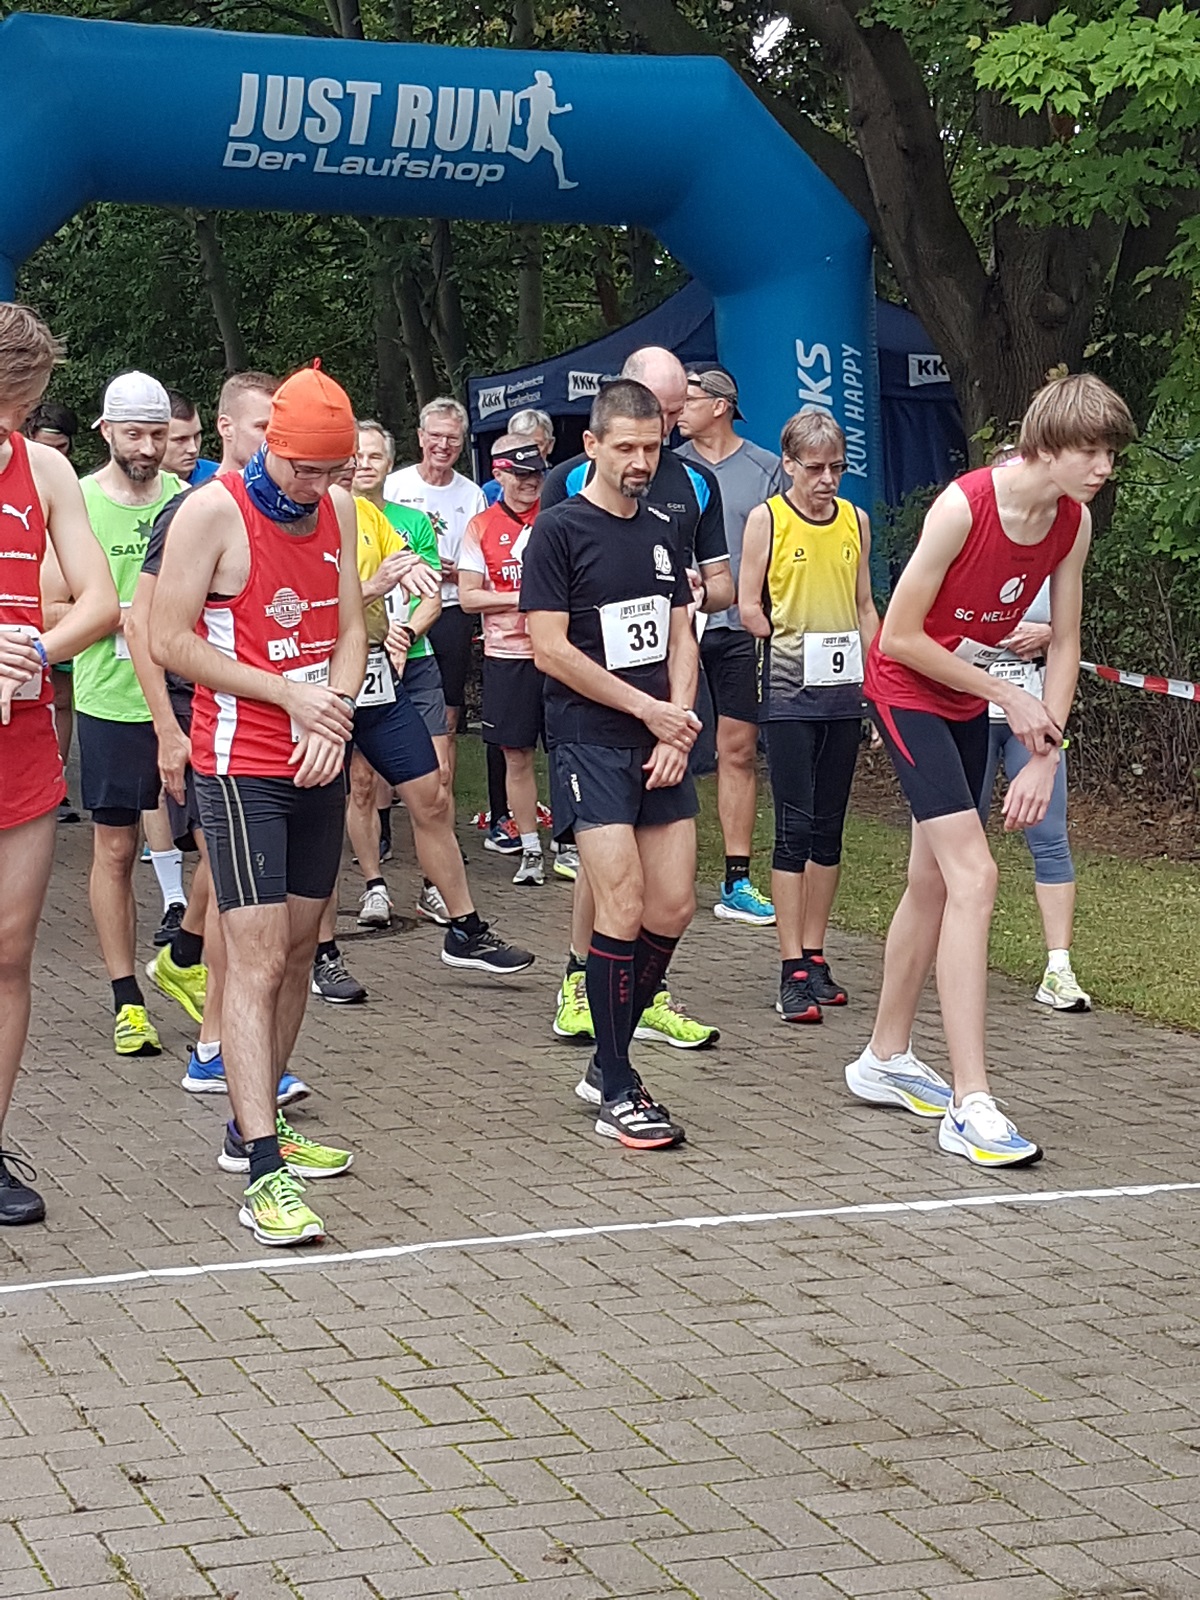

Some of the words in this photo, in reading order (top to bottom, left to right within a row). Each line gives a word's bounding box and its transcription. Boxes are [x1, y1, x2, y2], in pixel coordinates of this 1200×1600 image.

[228, 72, 382, 146] JUST
[391, 83, 514, 153] RUN
[222, 141, 306, 171] Der
[312, 147, 505, 187] Laufshop
[795, 338, 834, 417] KS
[841, 343, 865, 422] HAPPY
[845, 426, 868, 478] RUN
[110, 543, 150, 557] SAY
[954, 607, 975, 622] SC
[627, 620, 659, 652] 33
[832, 651, 845, 674] 9
[364, 670, 383, 695] 21
